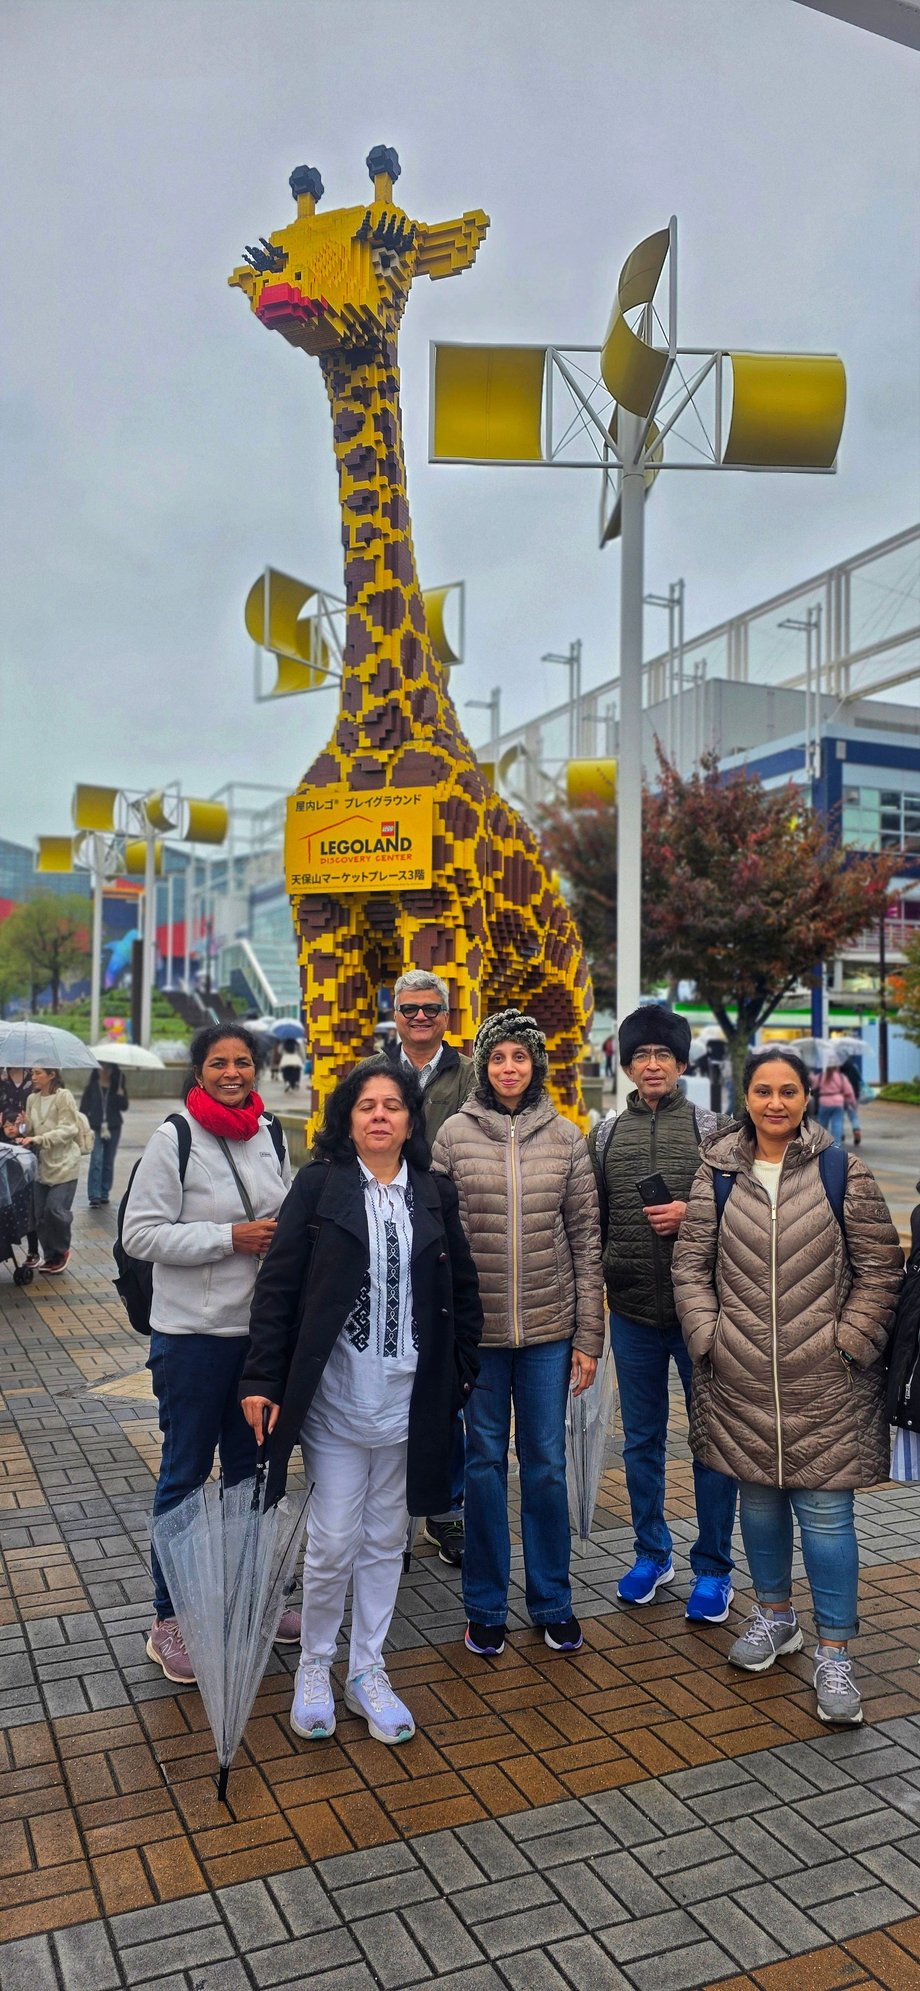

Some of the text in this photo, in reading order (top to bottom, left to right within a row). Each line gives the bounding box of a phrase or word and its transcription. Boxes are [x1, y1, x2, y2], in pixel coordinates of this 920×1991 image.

[344, 794, 421, 809] プレイグラウンド
[320, 821, 412, 856] LEGOLAND
[320, 854, 412, 865] DISCOVERY CENTER
